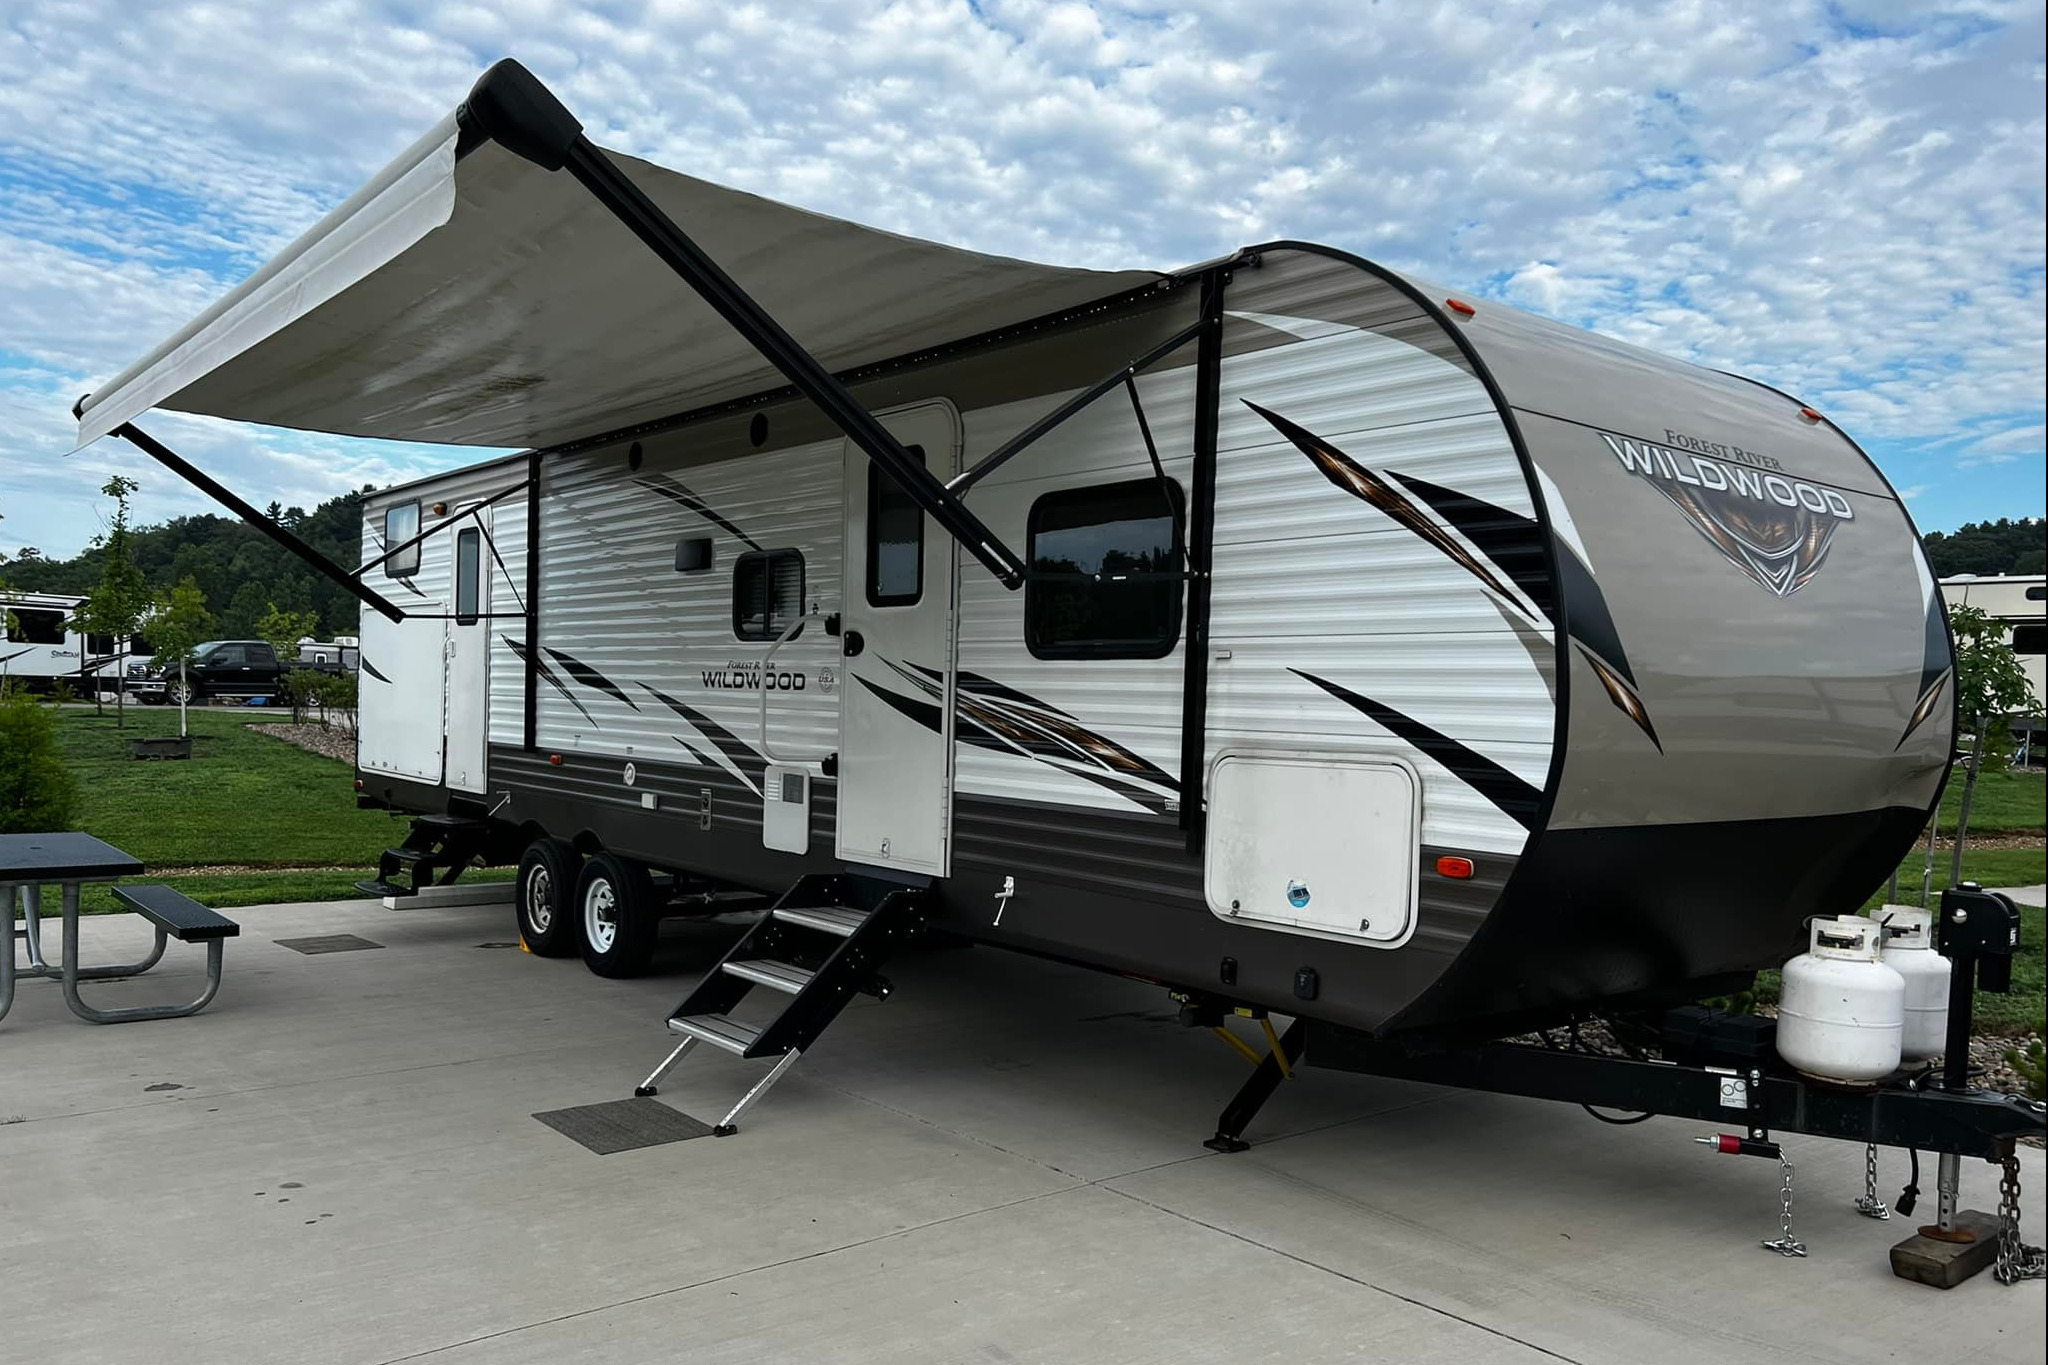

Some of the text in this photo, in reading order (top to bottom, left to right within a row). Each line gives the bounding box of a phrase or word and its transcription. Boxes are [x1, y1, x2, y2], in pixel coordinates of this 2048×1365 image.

[1664, 429, 1783, 471] FOREST RIVER
[1600, 432, 1854, 520] WILDWOOD
[727, 660, 776, 670] FOREST RER
